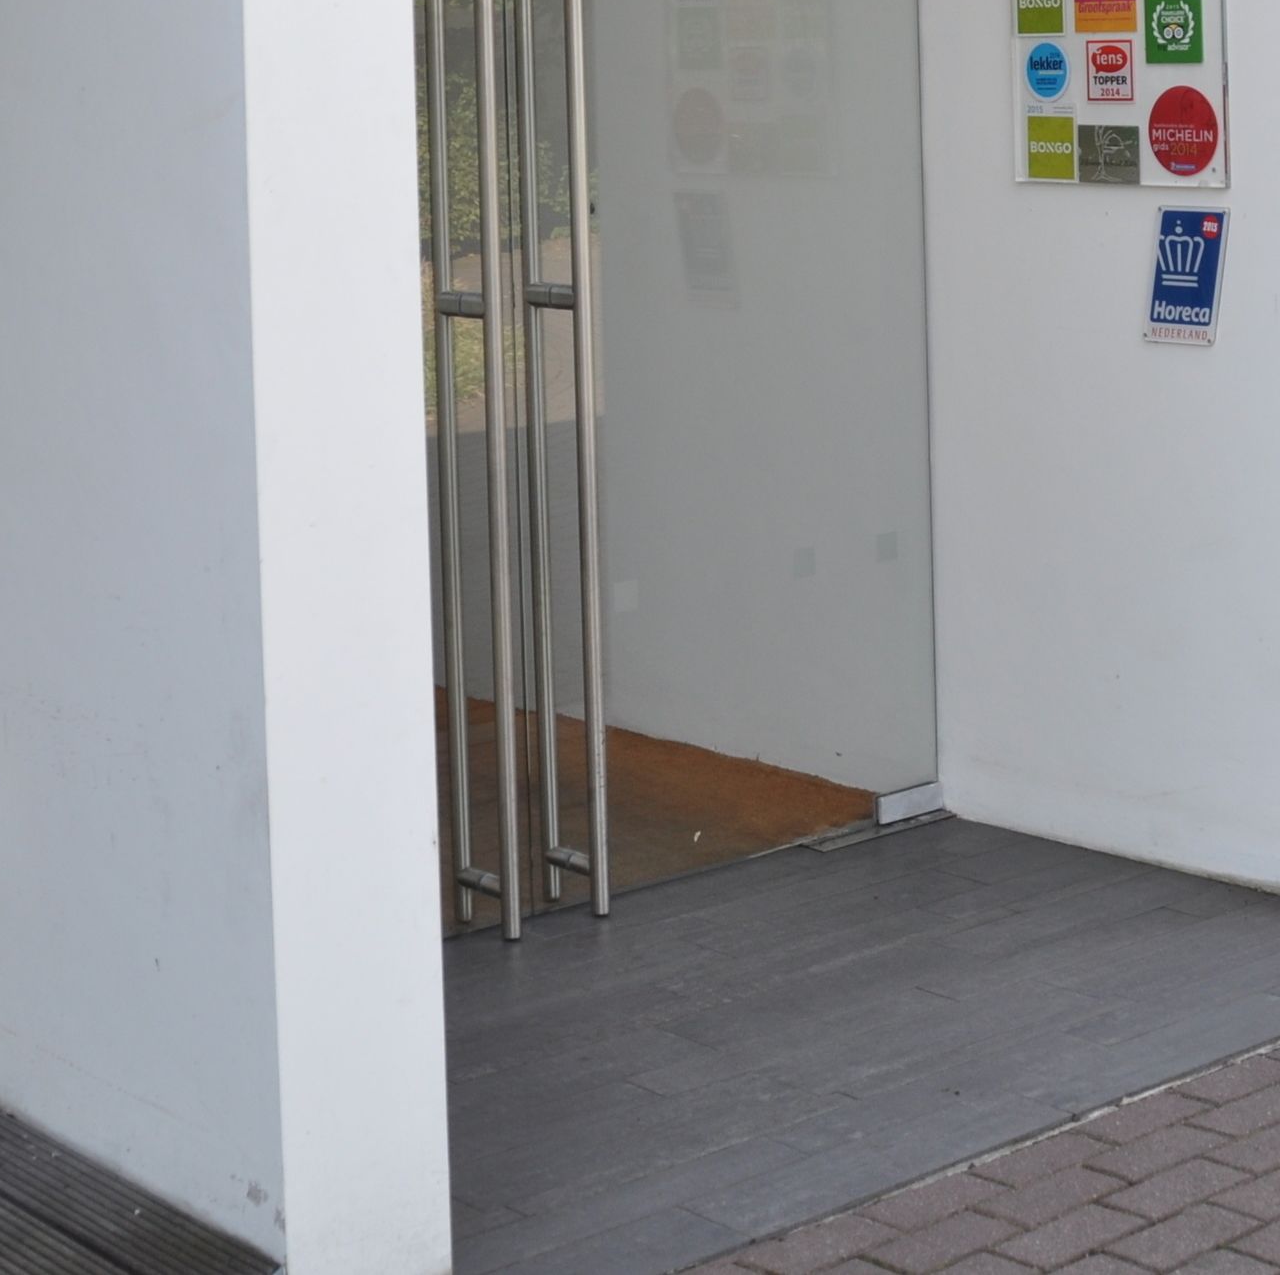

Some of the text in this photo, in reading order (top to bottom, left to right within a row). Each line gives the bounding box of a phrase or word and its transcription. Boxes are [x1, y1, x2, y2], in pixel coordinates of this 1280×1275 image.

[1030, 56, 1063, 70] lekker
[1096, 49, 1123, 65] iens
[1092, 75, 1128, 85] TOPPER
[1100, 87, 1121, 97] 2014
[1152, 128, 1214, 143] MICHELIN
[1030, 140, 1072, 154] BONGO
[1152, 142, 1197, 157] gids 2014
[1153, 300, 1210, 323] Horeca
[1151, 327, 1208, 341] NEDERLAND
